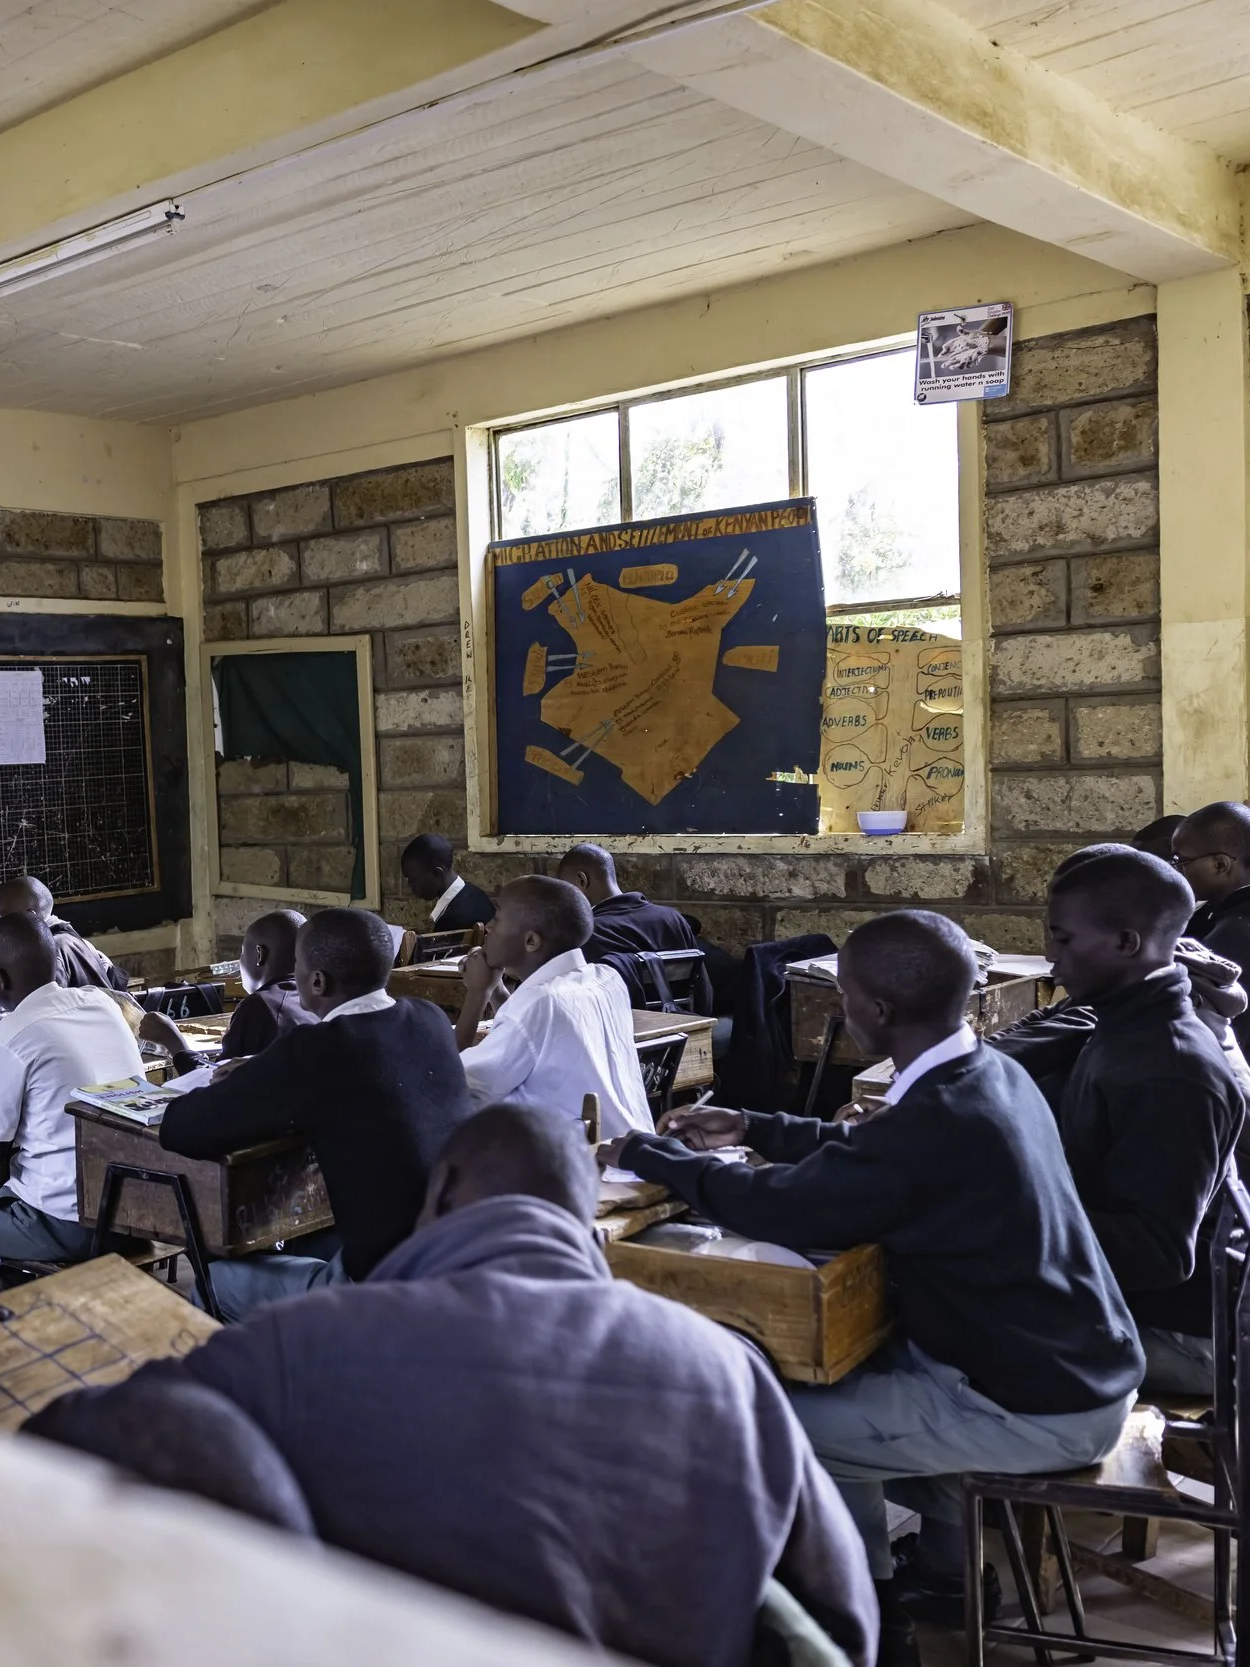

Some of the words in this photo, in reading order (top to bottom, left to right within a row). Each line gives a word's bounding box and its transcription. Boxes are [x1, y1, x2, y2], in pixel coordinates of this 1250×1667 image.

[921, 384, 951, 392] running
[715, 511, 768, 537] KENYAN
[867, 626, 885, 644] OF
[891, 629, 938, 643] SPEECH
[821, 714, 867, 727] ADVERBS
[925, 727, 959, 741] VERBS
